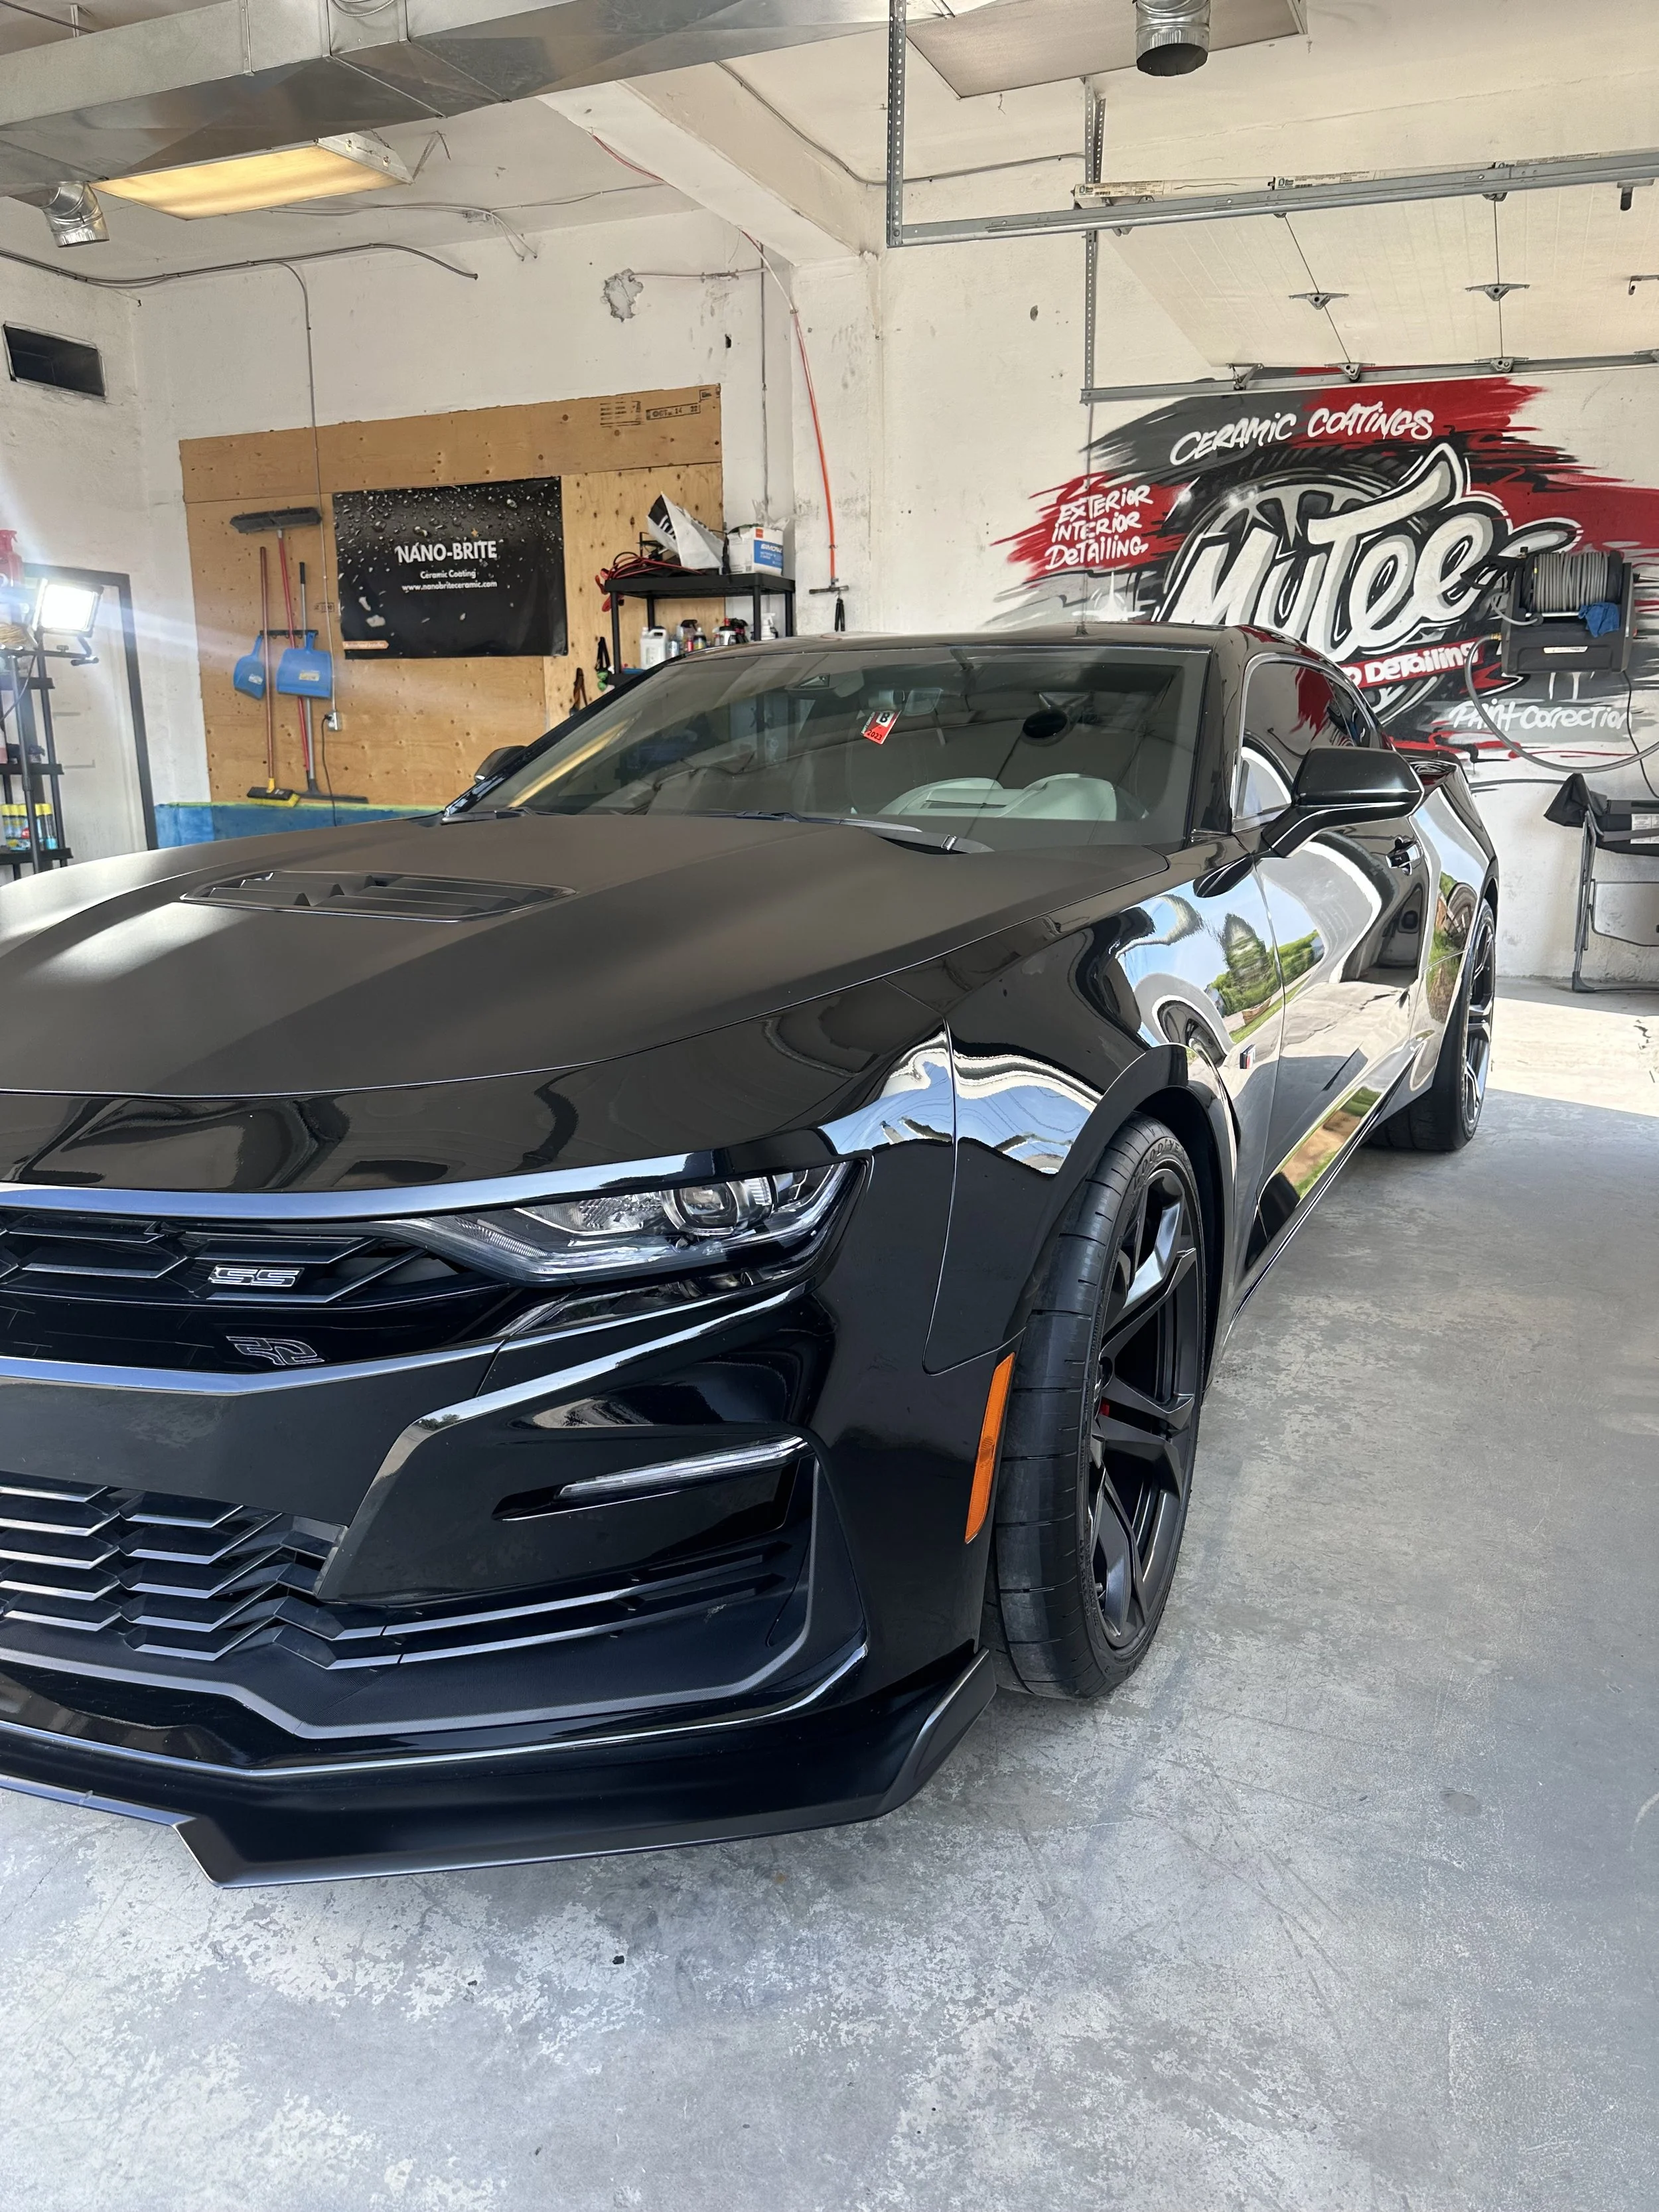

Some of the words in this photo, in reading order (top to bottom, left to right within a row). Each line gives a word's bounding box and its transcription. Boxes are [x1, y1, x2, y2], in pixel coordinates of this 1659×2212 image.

[397, 541, 497, 563] NANO-BRITE
[420, 570, 448, 579] Ceramic
[448, 568, 476, 579] Coating
[401, 581, 498, 591] www.nanobriteceramic.com
[867, 729, 883, 741] 2023
[208, 1264, 305, 1288] SS
